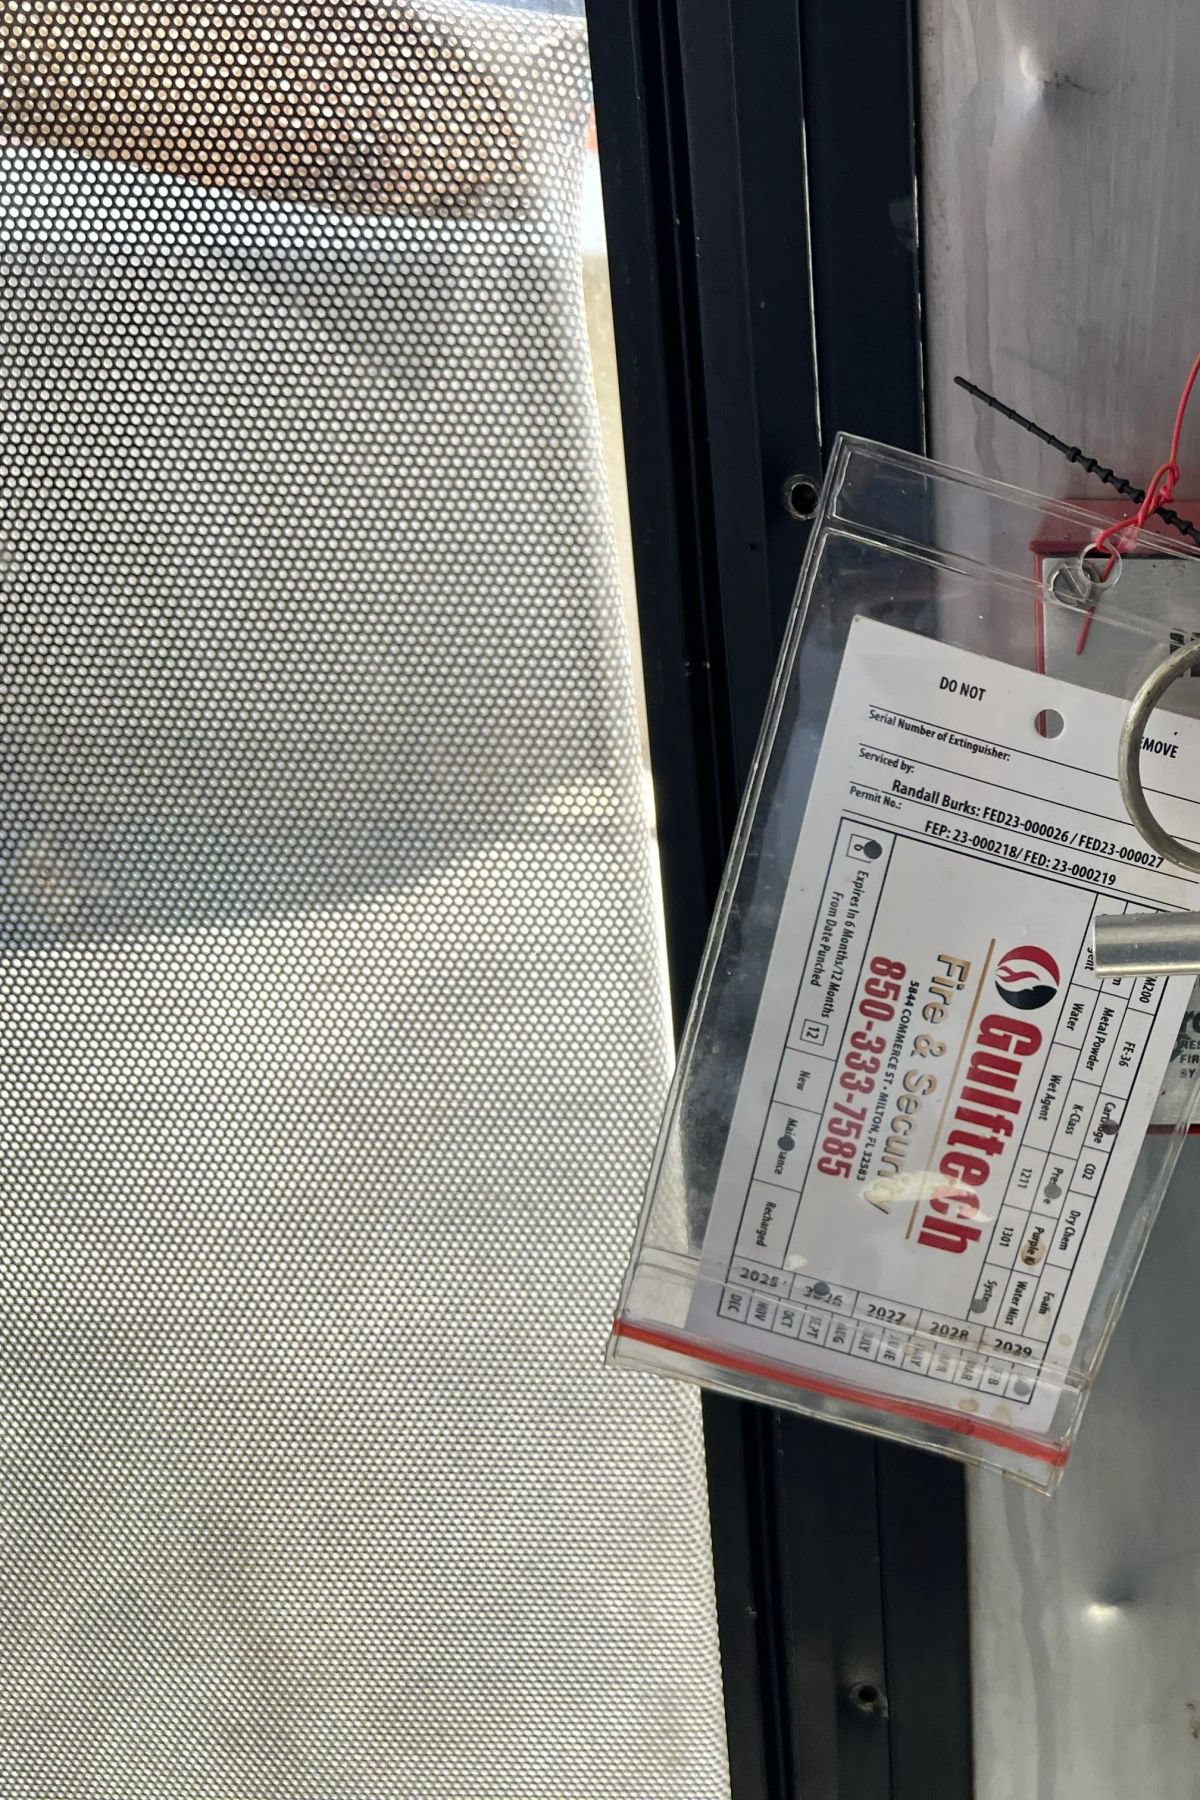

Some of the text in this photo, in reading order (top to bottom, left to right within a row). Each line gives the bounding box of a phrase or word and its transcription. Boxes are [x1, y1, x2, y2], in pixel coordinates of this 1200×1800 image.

[940, 676, 987, 702] DO NOT
[868, 709, 1010, 761] Serial Number of Extinguisher:
[1140, 736, 1179, 758] EMOVE
[858, 747, 915, 774] Serviced by:
[849, 785, 902, 809] Permit No.:
[891, 778, 1165, 868] Randall Burks: FED23-000026 / FED23-000027
[925, 820, 1117, 887] FEP: 23-000218/ FED: 23-000219
[809, 891, 844, 987] From Date Punched
[820, 869, 869, 1018] Expires In 6 Months/12 Months
[1084, 946, 1095, 971] gent
[922, 954, 972, 1024] Fire
[1139, 976, 1157, 1002] M200
[1066, 1002, 1084, 1031] Water
[805, 1026, 820, 1039] 12
[910, 1033, 947, 1059] &
[1085, 1007, 1114, 1071] Metal Powder
[815, 954, 907, 1180] 850-333-7585
[1118, 1041, 1135, 1067] FE-36
[796, 1070, 811, 1091] New
[856, 980, 919, 1181] 5844 COMMERCE ST MILTON, FL 32583
[1037, 1074, 1062, 1120] Wet Agent
[1064, 1103, 1084, 1135] K-Class
[1092, 1101, 1115, 1143] Cartdge
[773, 1117, 798, 1175] Maiance
[917, 1014, 1041, 1253] Gulftech
[1017, 1168, 1032, 1188] 1211
[1042, 1166, 1064, 1204] Prese
[1081, 1163, 1096, 1180] CO2
[755, 1201, 776, 1247] Recharged
[999, 1227, 1014, 1247] 1301
[1058, 1209, 1081, 1250] Dry Chem
[1026, 1226, 1044, 1255] Purple
[739, 1266, 780, 1288] 2025
[728, 1293, 743, 1313] DEC
[803, 1285, 843, 1307] 26
[976, 1279, 997, 1307] Syste
[1004, 1280, 1028, 1325] Water Mist
[1038, 1291, 1054, 1314] Foam
[755, 1301, 769, 1322] NOV
[781, 1310, 795, 1329] OCT
[865, 1304, 907, 1324] 2027
[930, 1321, 970, 1342] 2028
[994, 1338, 1033, 1358] 2029
